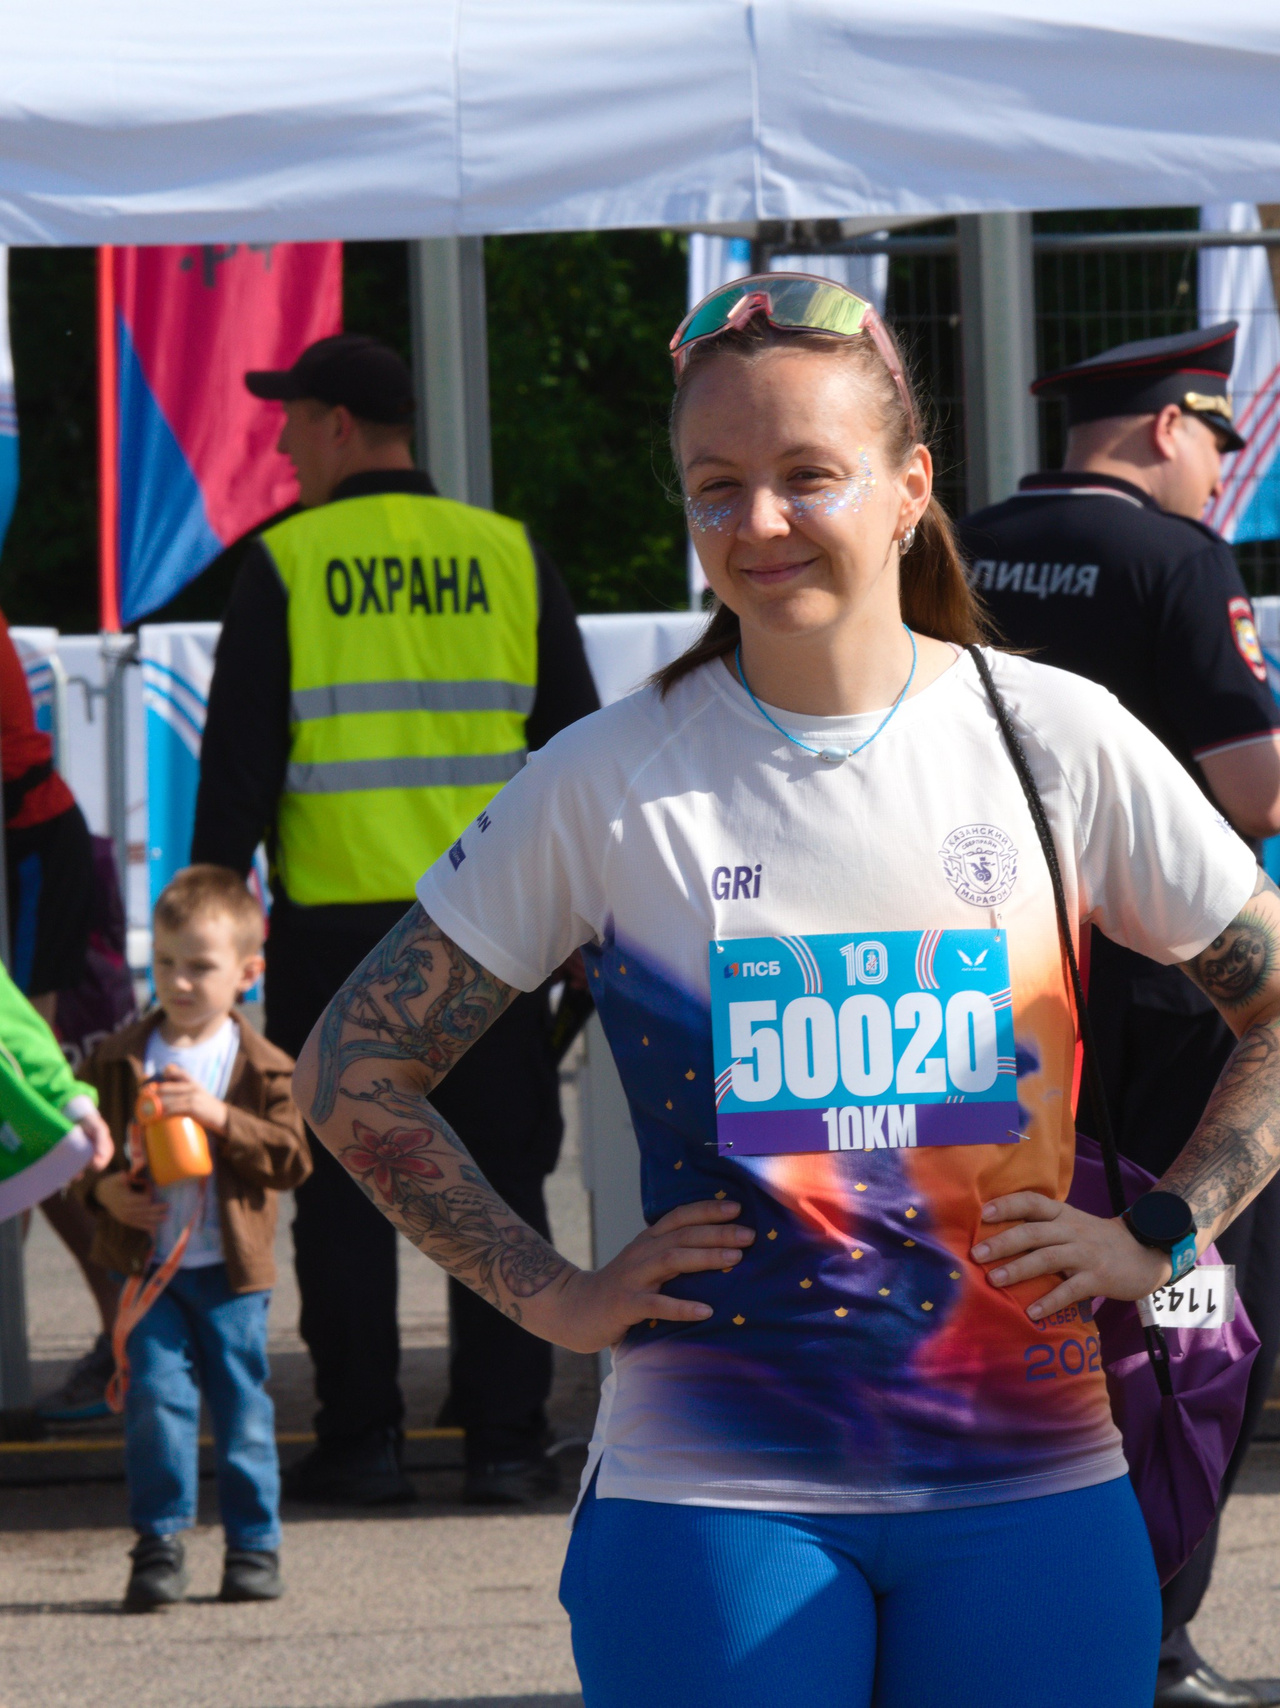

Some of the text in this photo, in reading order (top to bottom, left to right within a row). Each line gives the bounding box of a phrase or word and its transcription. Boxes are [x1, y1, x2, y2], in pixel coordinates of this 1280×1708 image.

[326, 556, 491, 618] ОХРАНА
[960, 888, 1008, 904] МАРАФОН
[742, 960, 781, 978] ПСБ
[839, 940, 889, 987] 10
[728, 990, 999, 1103] 50020
[1152, 1287, 1217, 1314] 1143
[1023, 1335, 1100, 1382] 202
